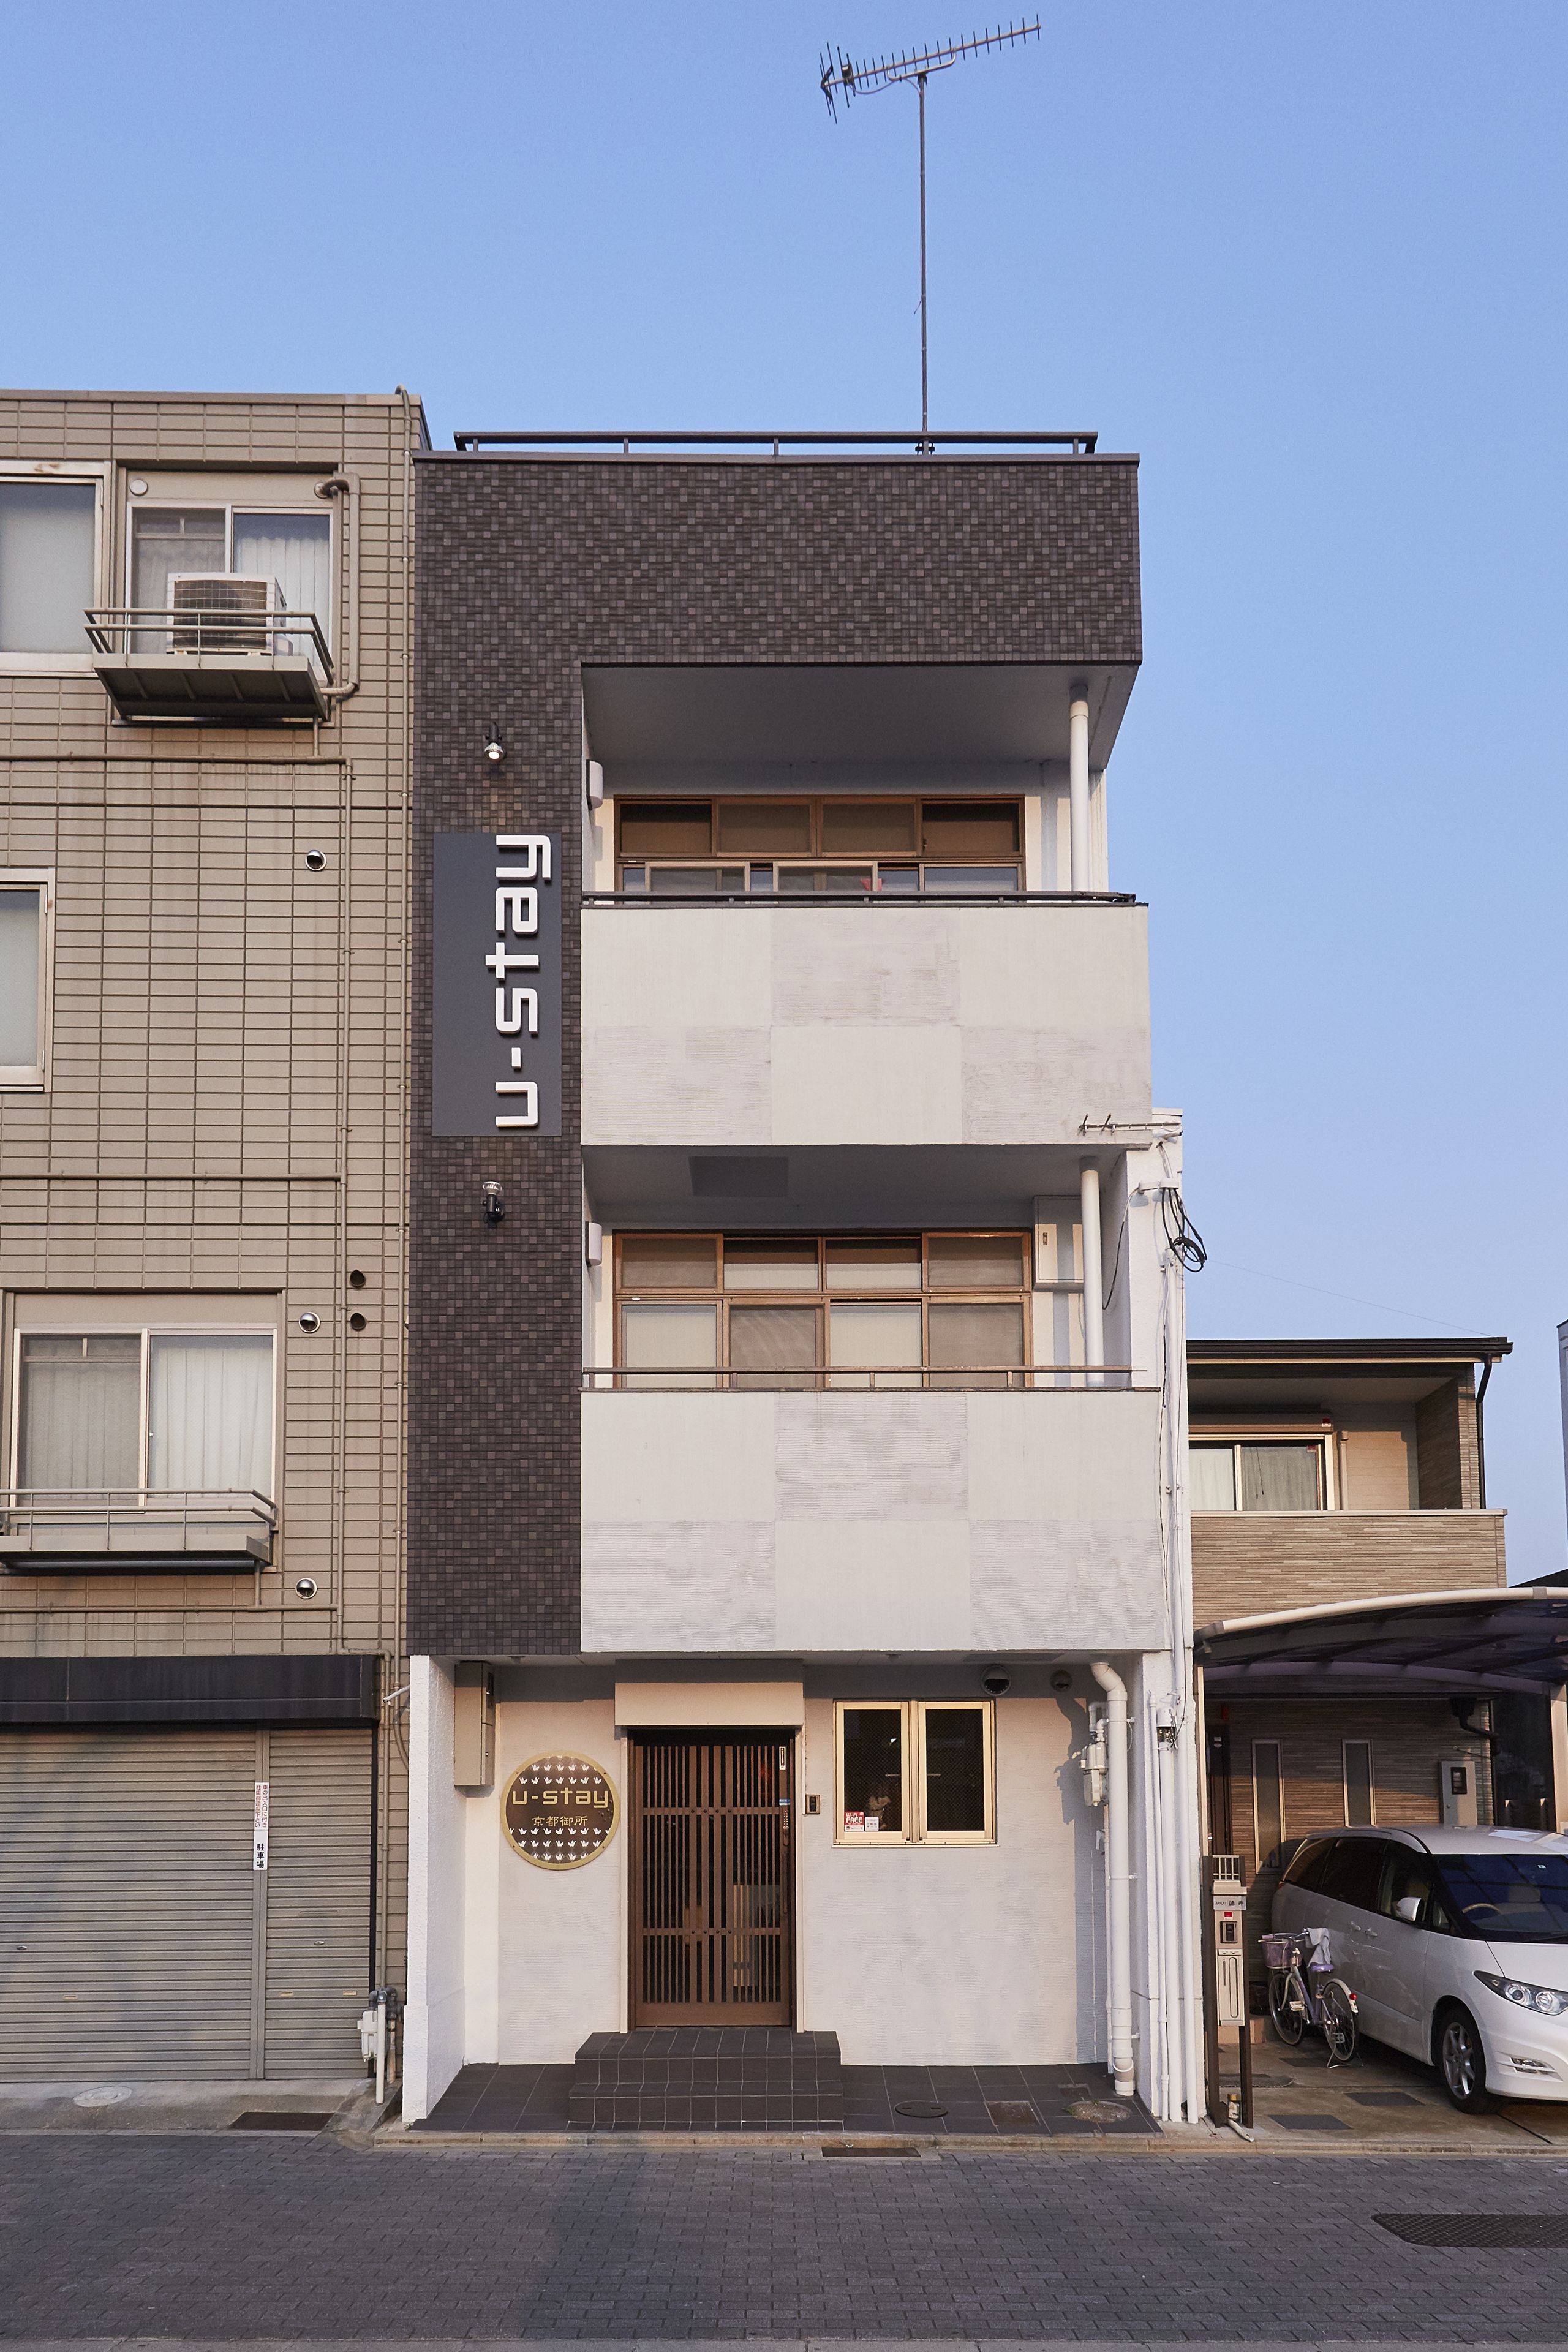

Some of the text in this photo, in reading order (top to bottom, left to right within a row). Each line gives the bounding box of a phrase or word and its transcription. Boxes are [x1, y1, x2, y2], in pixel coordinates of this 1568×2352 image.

[485, 835, 551, 1128] u-stay
[512, 1787, 608, 1809] u-stay
[532, 1815, 588, 1827] 京都御所
